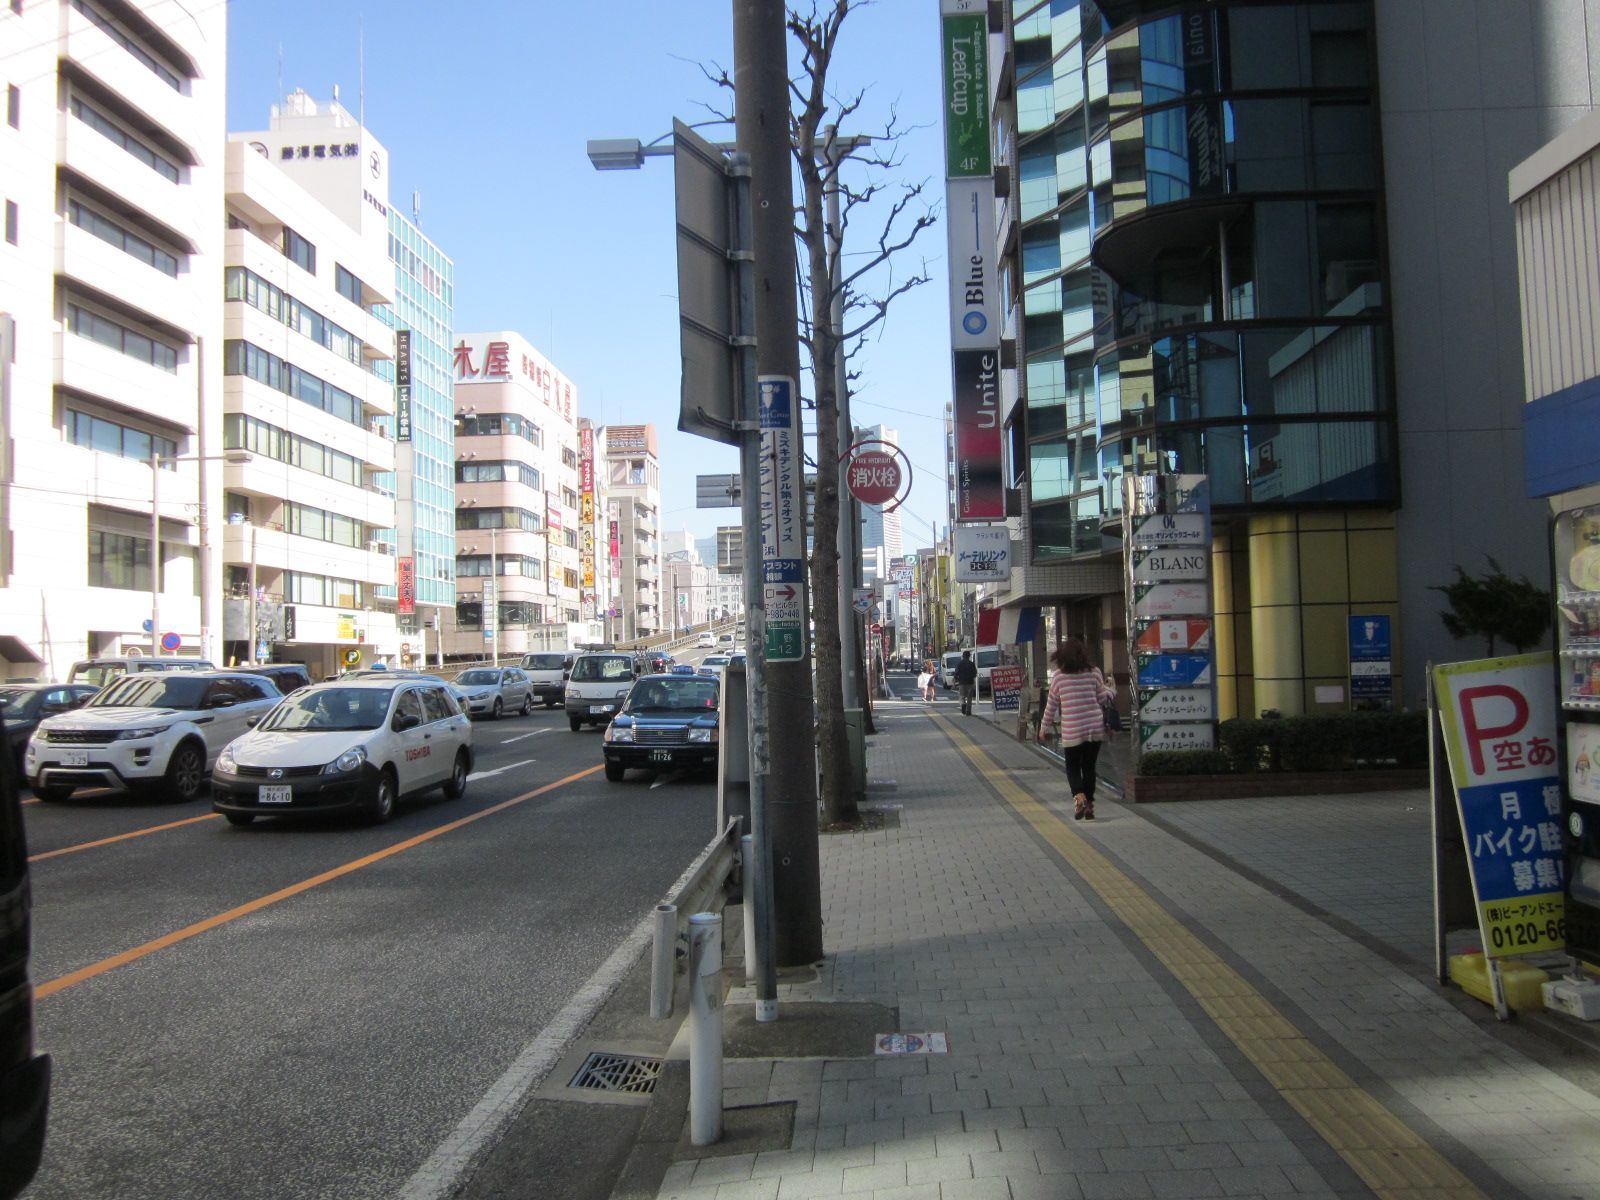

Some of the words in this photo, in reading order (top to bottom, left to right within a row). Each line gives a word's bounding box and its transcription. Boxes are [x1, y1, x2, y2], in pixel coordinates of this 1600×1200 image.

[952, 37, 971, 116] Leafcup
[960, 157, 979, 170] 4F
[965, 255, 984, 306] Blue
[400, 336, 408, 381] HEARTS
[453, 340, 511, 377] 木屋
[976, 354, 997, 428] Unite
[852, 466, 897, 488] 消火栓
[959, 549, 1007, 562] メーテルリンク
[1149, 556, 1204, 571] BLANC
[1459, 684, 1530, 776] P
[405, 744, 431, 761] TOSHIBA
[266, 792, 290, 802] 86-10
[1511, 857, 1564, 892] 募集
